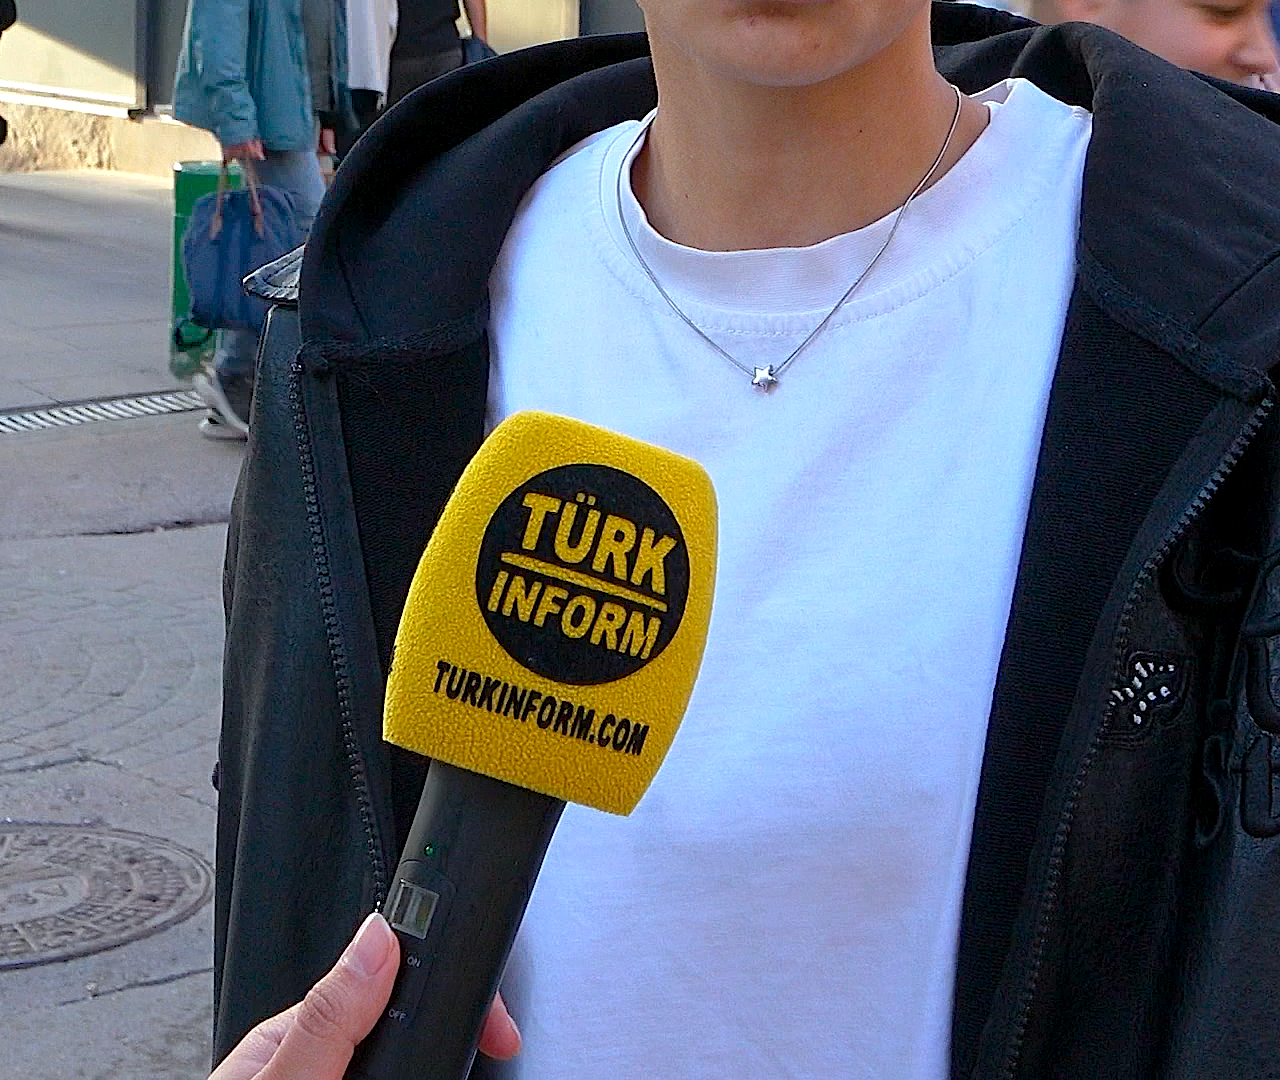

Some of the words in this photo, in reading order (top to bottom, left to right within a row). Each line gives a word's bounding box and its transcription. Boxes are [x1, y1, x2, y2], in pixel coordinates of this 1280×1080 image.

[521, 492, 679, 596] TÜRK
[487, 570, 662, 660] INFORM
[431, 660, 650, 757] TURKINFORM.COM
[407, 955, 421, 968] ON
[388, 1008, 407, 1022] OFF
